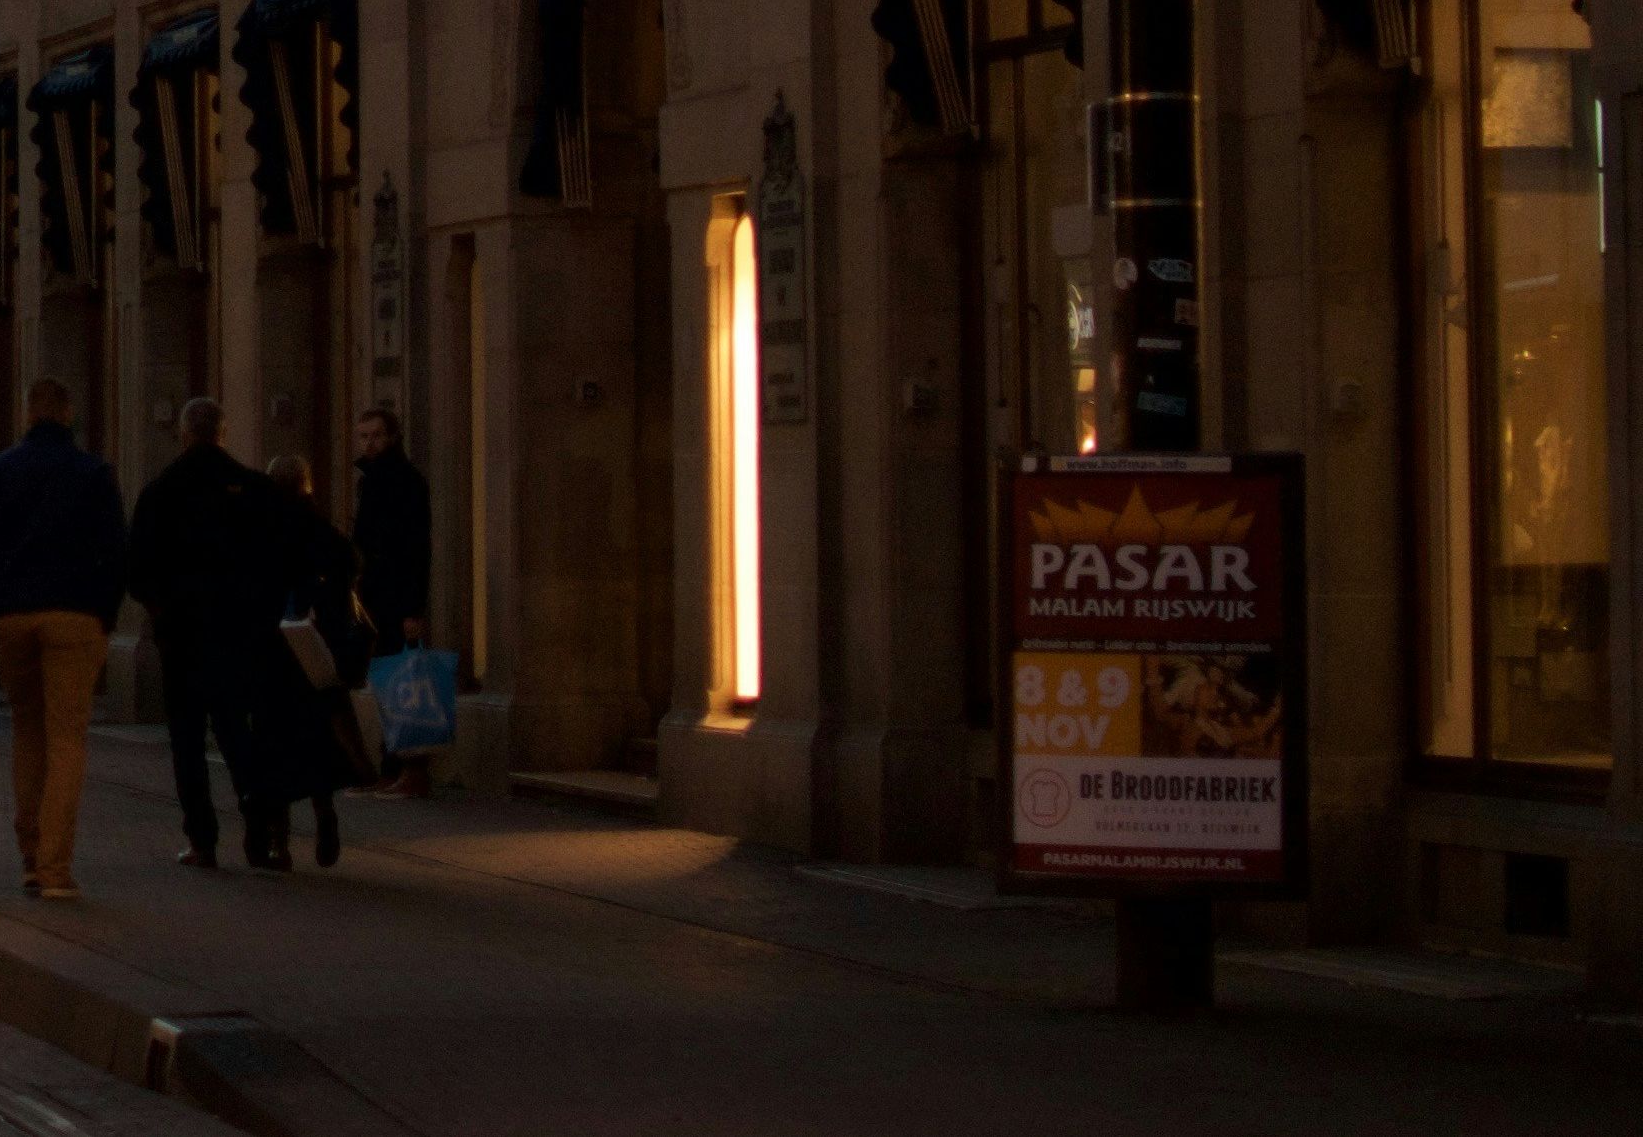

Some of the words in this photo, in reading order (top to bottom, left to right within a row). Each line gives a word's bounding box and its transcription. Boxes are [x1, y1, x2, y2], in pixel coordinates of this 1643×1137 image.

[1030, 542, 1259, 592] PASAR
[1027, 597, 1126, 618] MALAM
[1132, 598, 1258, 623] RIJSWIJK
[1016, 663, 1047, 708] 8
[1055, 668, 1088, 708] &
[1096, 665, 1132, 710] 9
[1016, 713, 1113, 751] NOV
[1078, 772, 1105, 800] DE
[1110, 769, 1278, 804] BROODFABRIEK
